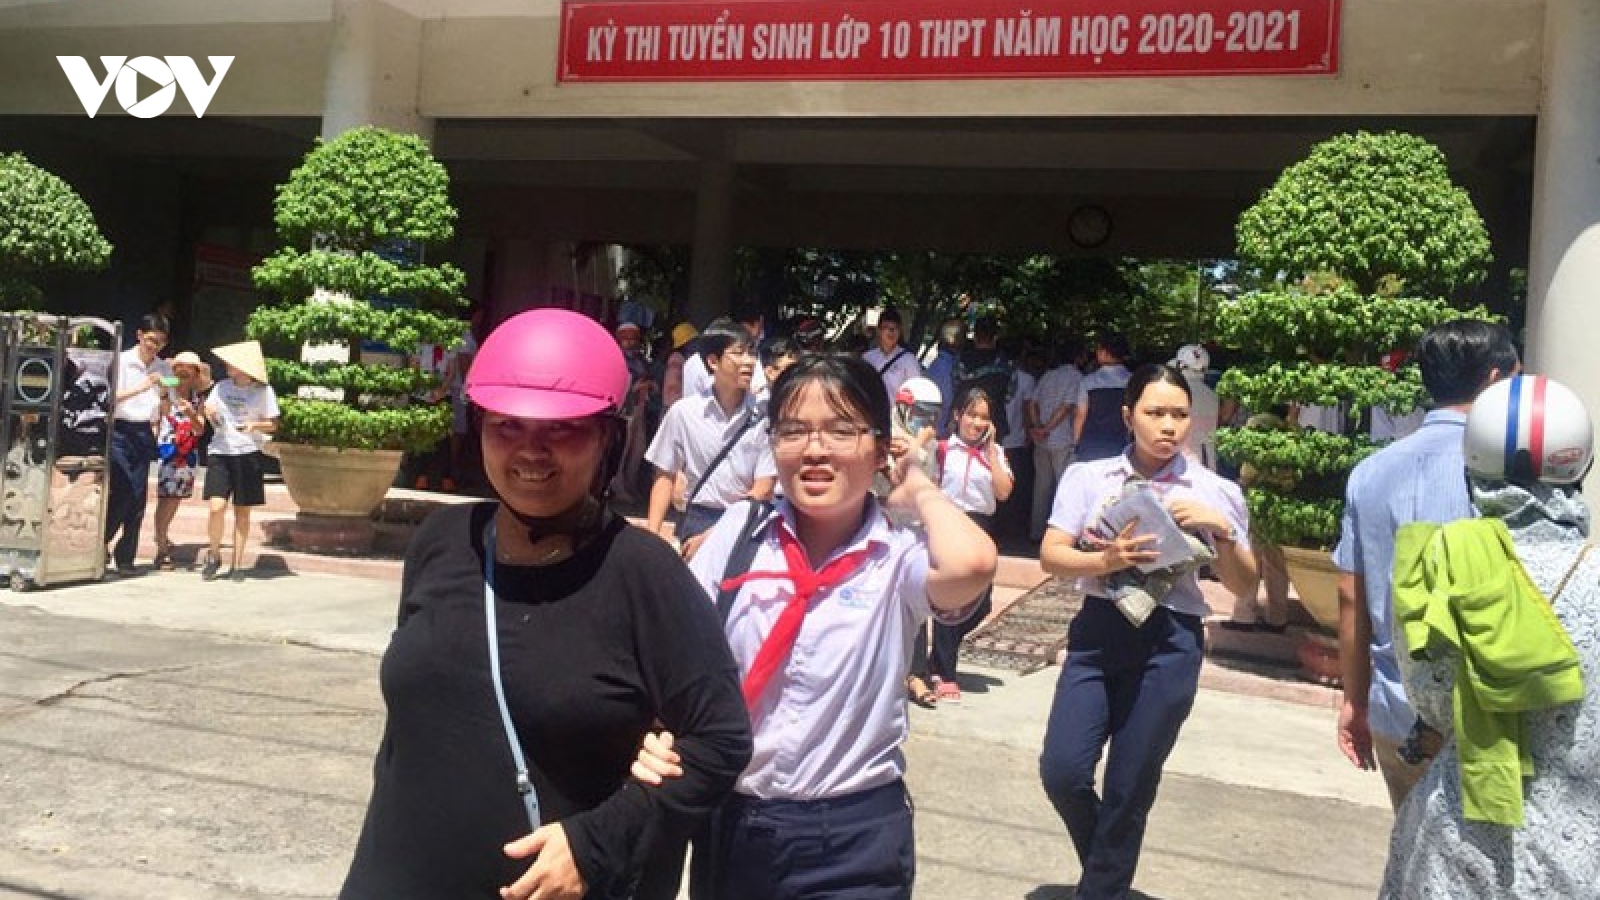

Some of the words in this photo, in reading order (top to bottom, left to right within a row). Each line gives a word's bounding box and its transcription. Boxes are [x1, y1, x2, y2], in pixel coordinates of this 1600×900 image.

[586, 19, 618, 61] KỲ
[625, 25, 660, 61] THI
[667, 9, 744, 61] TUYỂN
[751, 22, 813, 60] SINH
[820, 13, 870, 59] LỚP
[879, 21, 911, 58] 10
[919, 19, 986, 57] THPT
[993, 9, 1061, 56] NĂM
[1069, 15, 1130, 63] HỌC
[1137, 9, 1301, 54] 2020-2021
